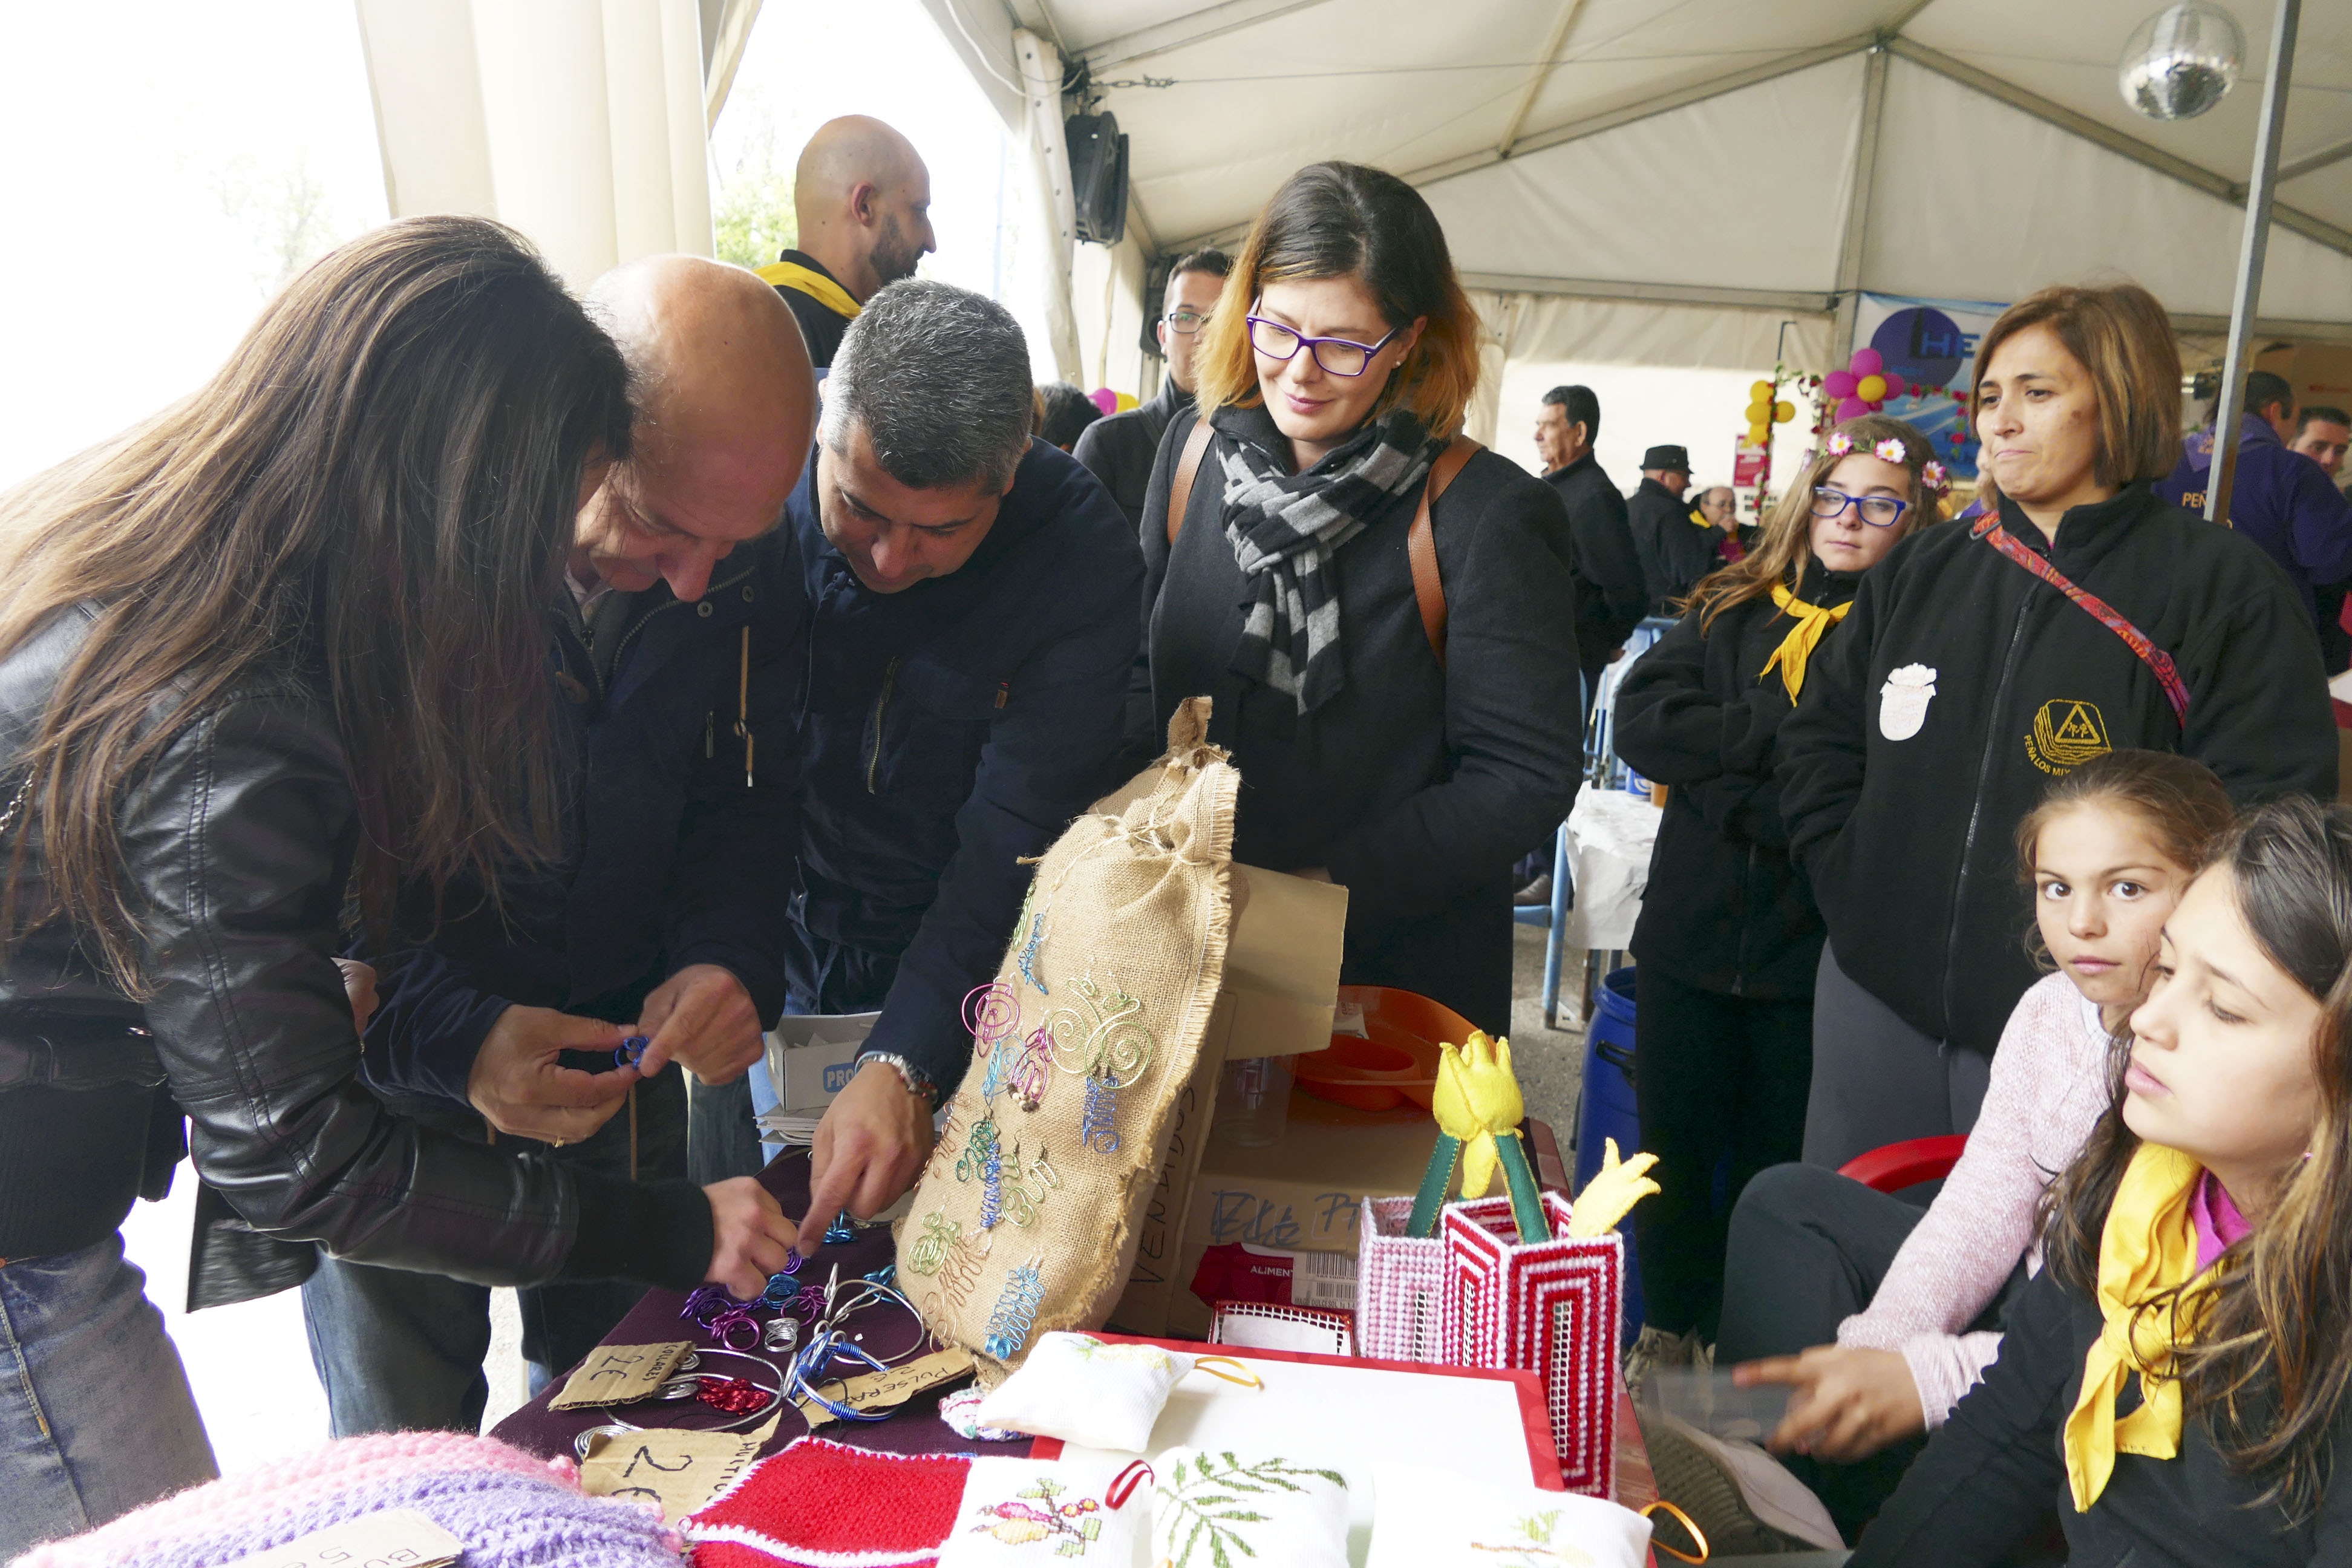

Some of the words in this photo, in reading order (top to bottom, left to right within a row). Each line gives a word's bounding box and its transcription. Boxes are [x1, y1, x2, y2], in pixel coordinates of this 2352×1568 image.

[2024, 734, 2037, 761] PEÑA
[2034, 757, 2051, 773] LOS
[827, 1068, 854, 1088] PRO
[1250, 1265, 1294, 1278] ALIMEN
[642, 1345, 678, 1381] COLLARES
[706, 1442, 757, 1501] MULTIU
